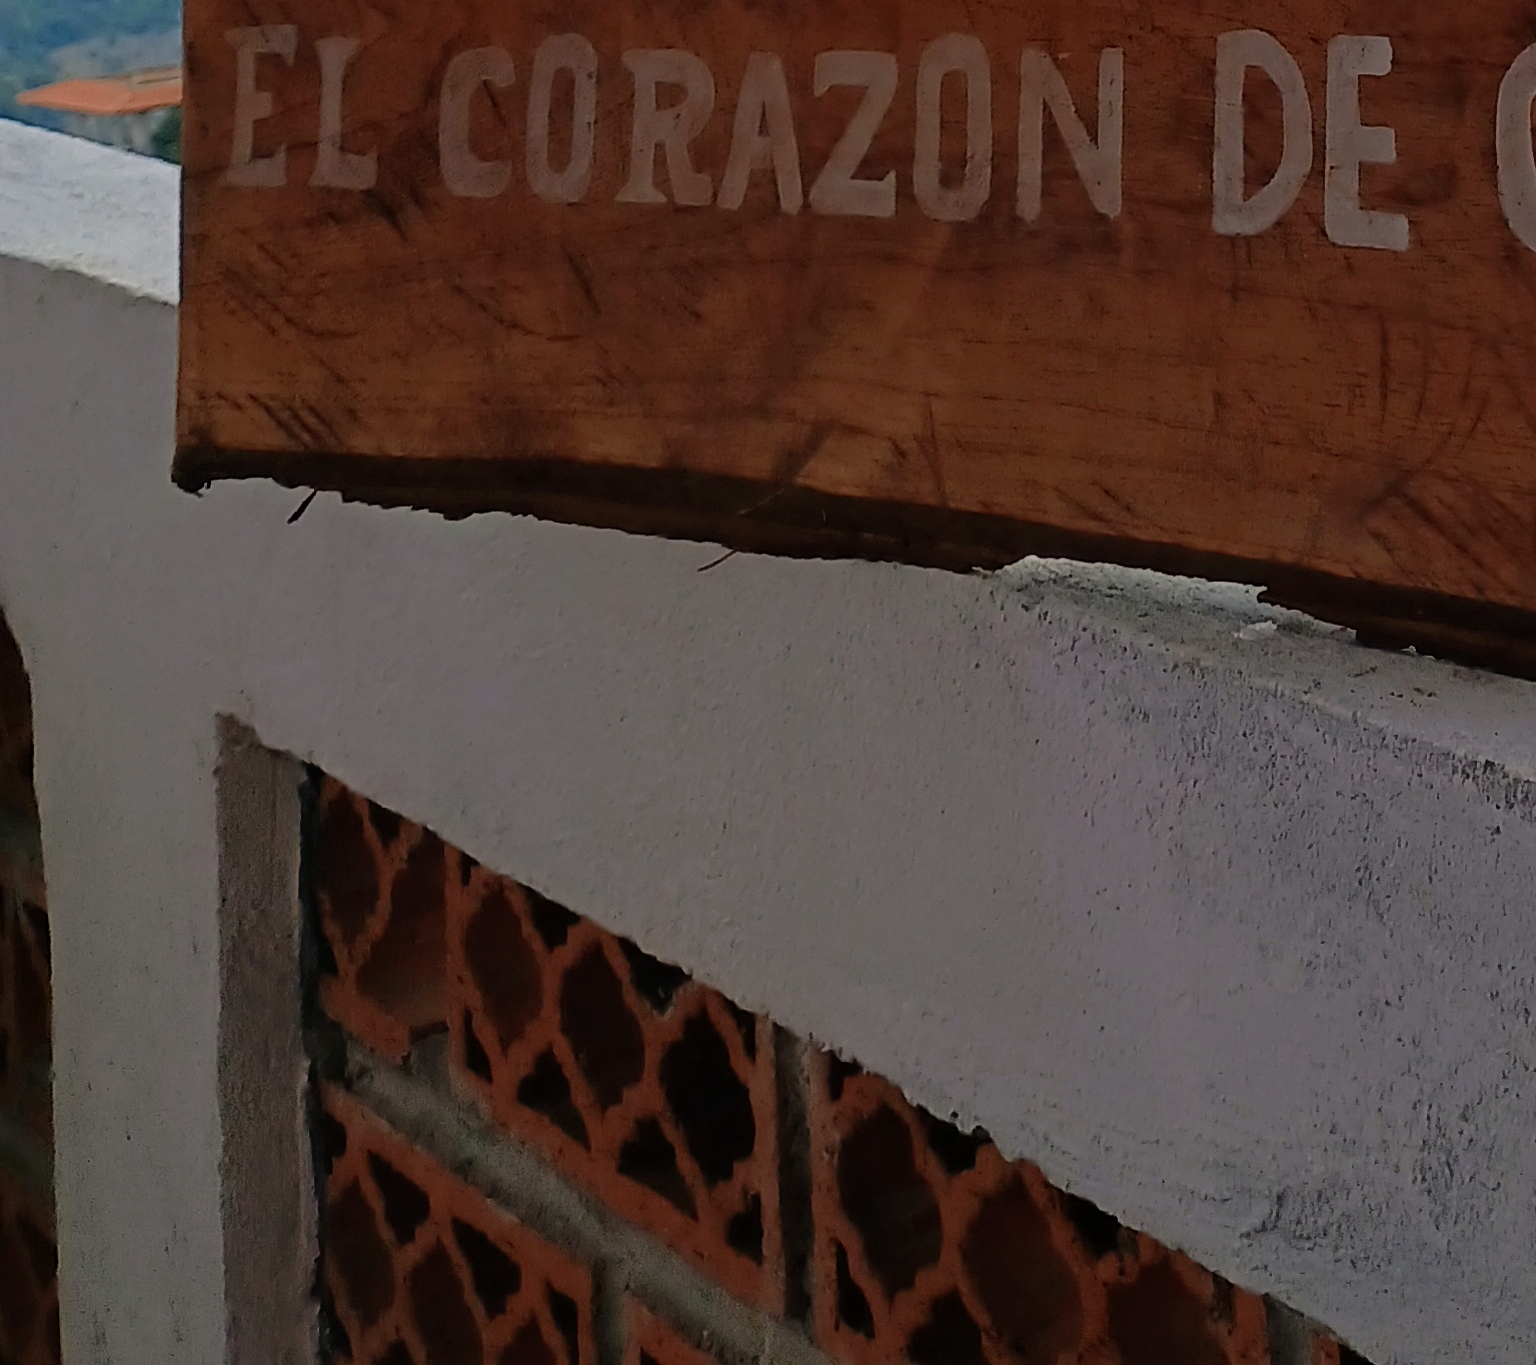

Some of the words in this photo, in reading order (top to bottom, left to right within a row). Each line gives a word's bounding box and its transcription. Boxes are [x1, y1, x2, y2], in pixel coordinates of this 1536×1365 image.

[222, 22, 379, 192] EL
[437, 32, 1124, 224] CORAZON
[1210, 28, 1411, 252] DE
